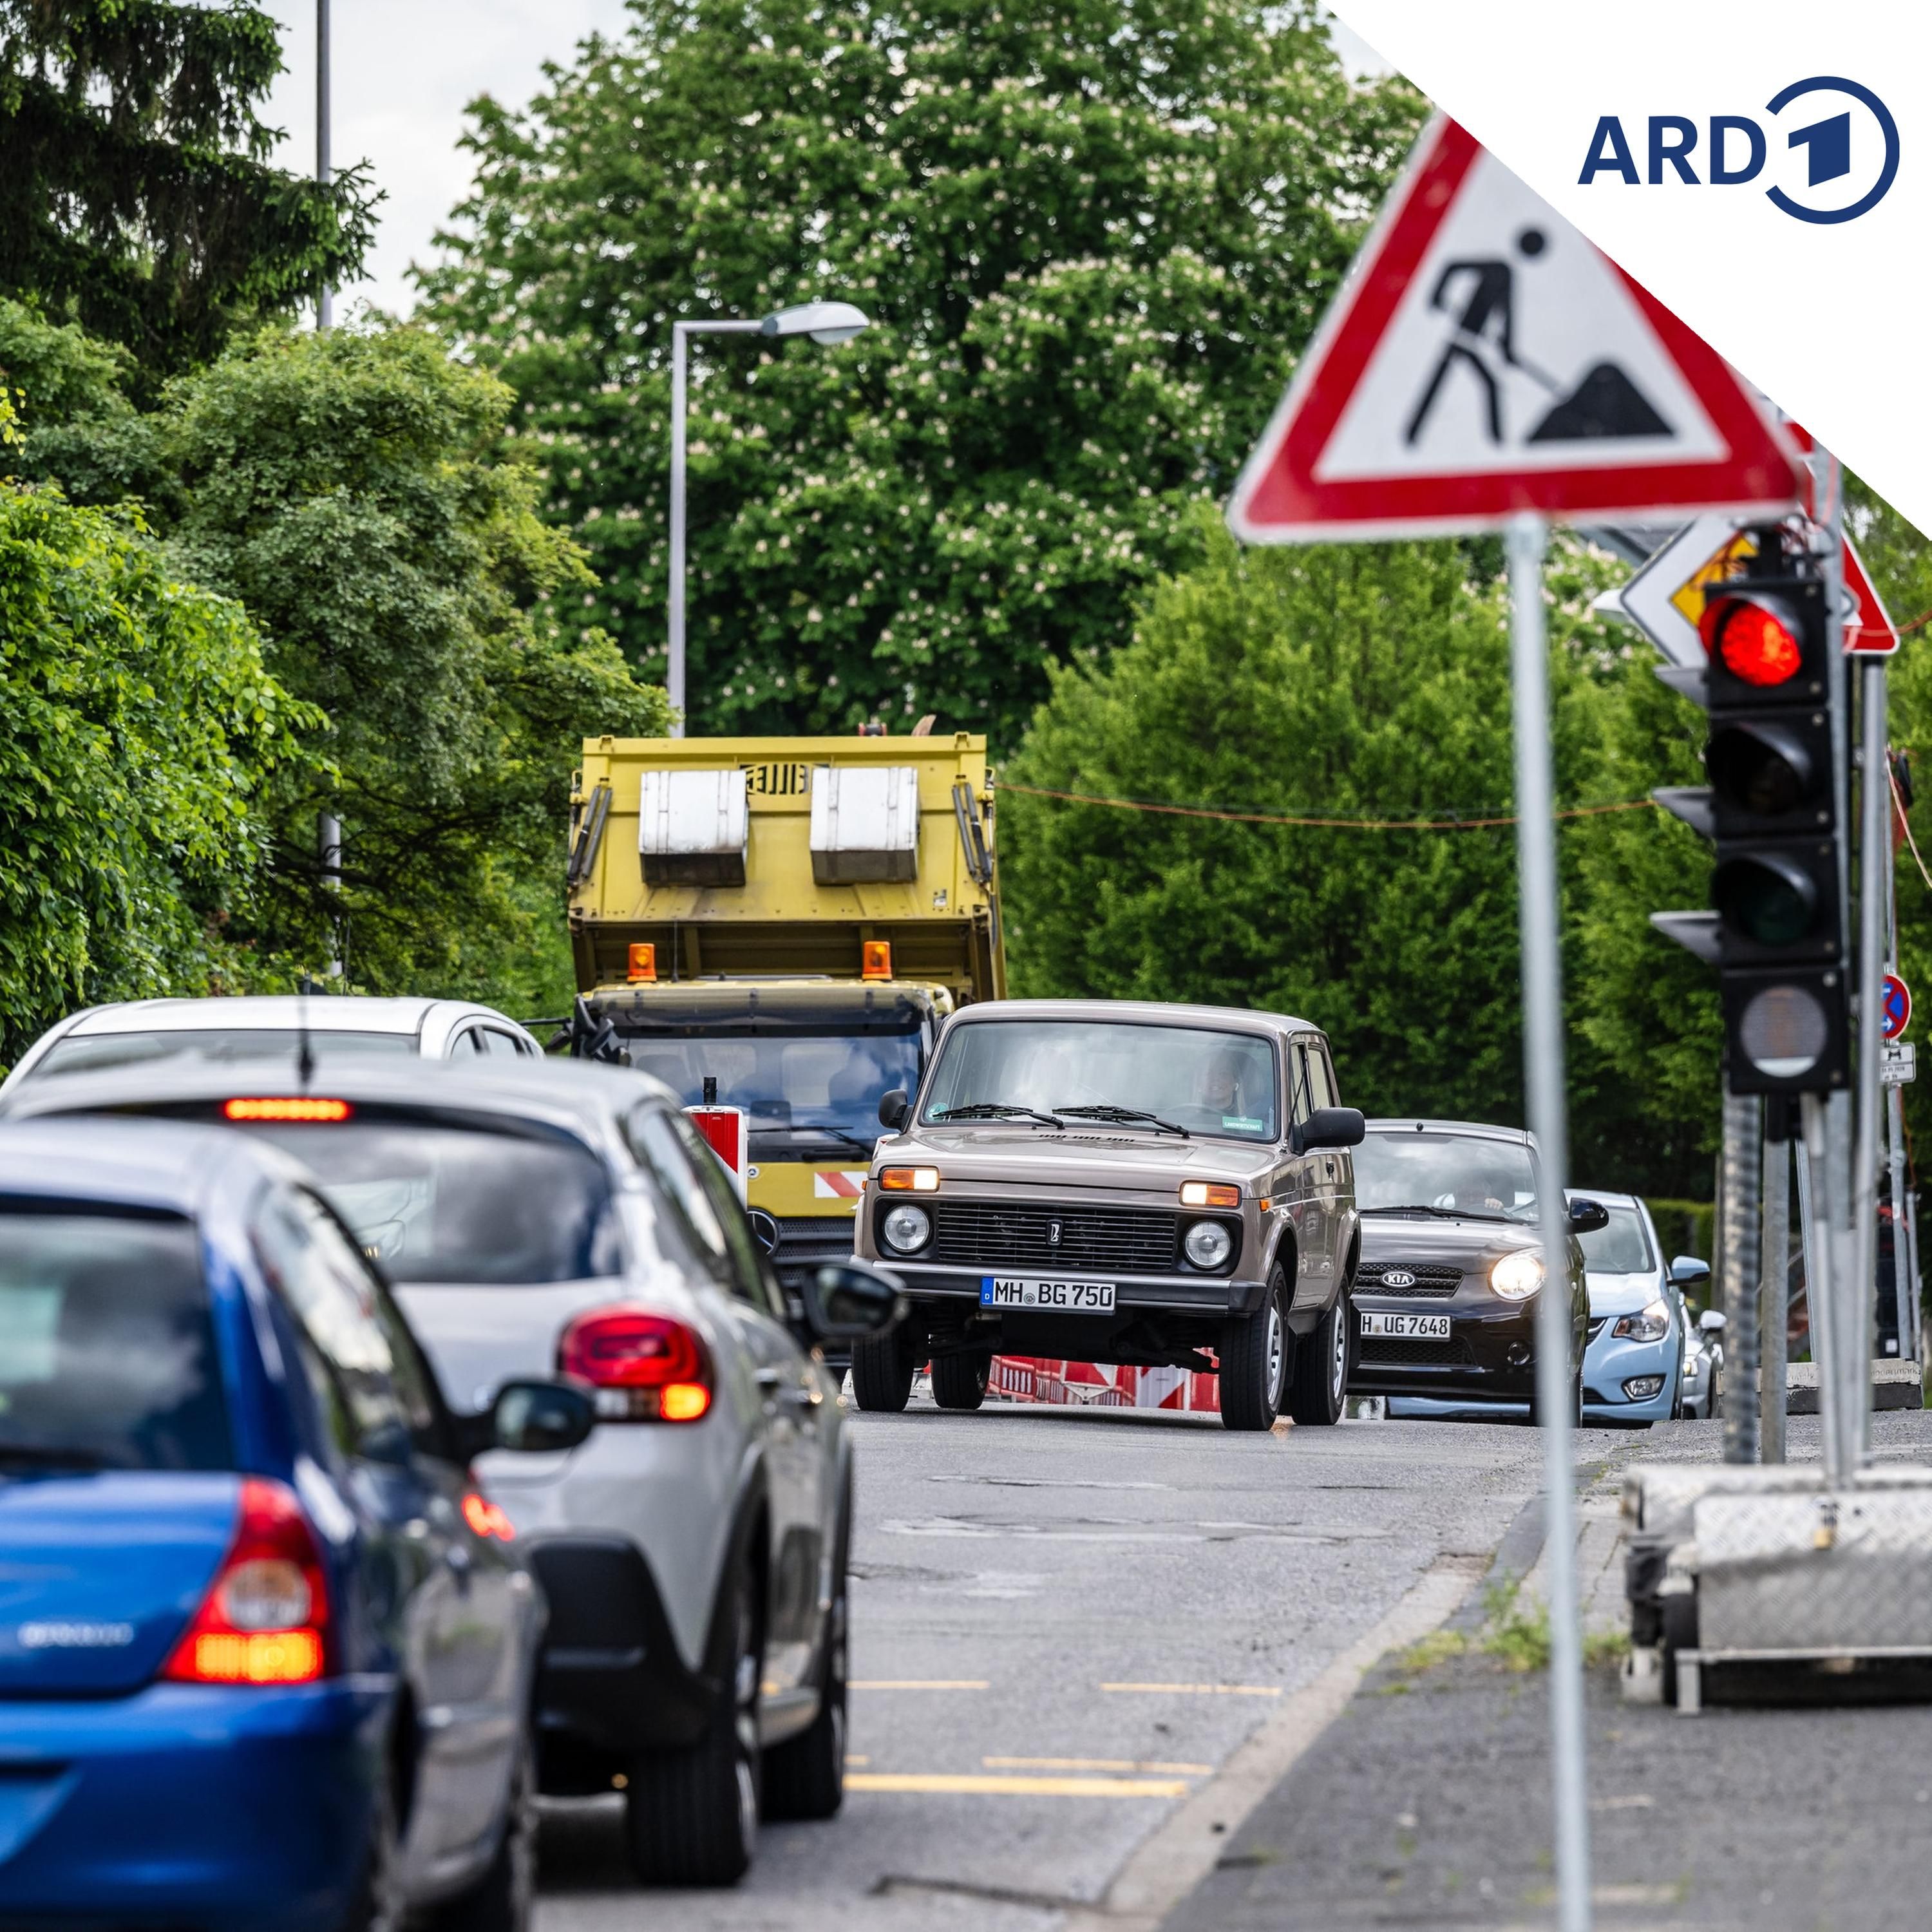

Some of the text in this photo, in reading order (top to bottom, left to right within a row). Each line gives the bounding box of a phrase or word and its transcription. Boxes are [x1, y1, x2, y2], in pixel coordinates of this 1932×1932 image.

[1387, 1274, 1410, 1284] KIA
[995, 1282, 1023, 1303] MH
[1038, 1283, 1066, 1305] BG
[1072, 1285, 1112, 1307] 750
[1362, 1316, 1448, 1335] H UG 7648
